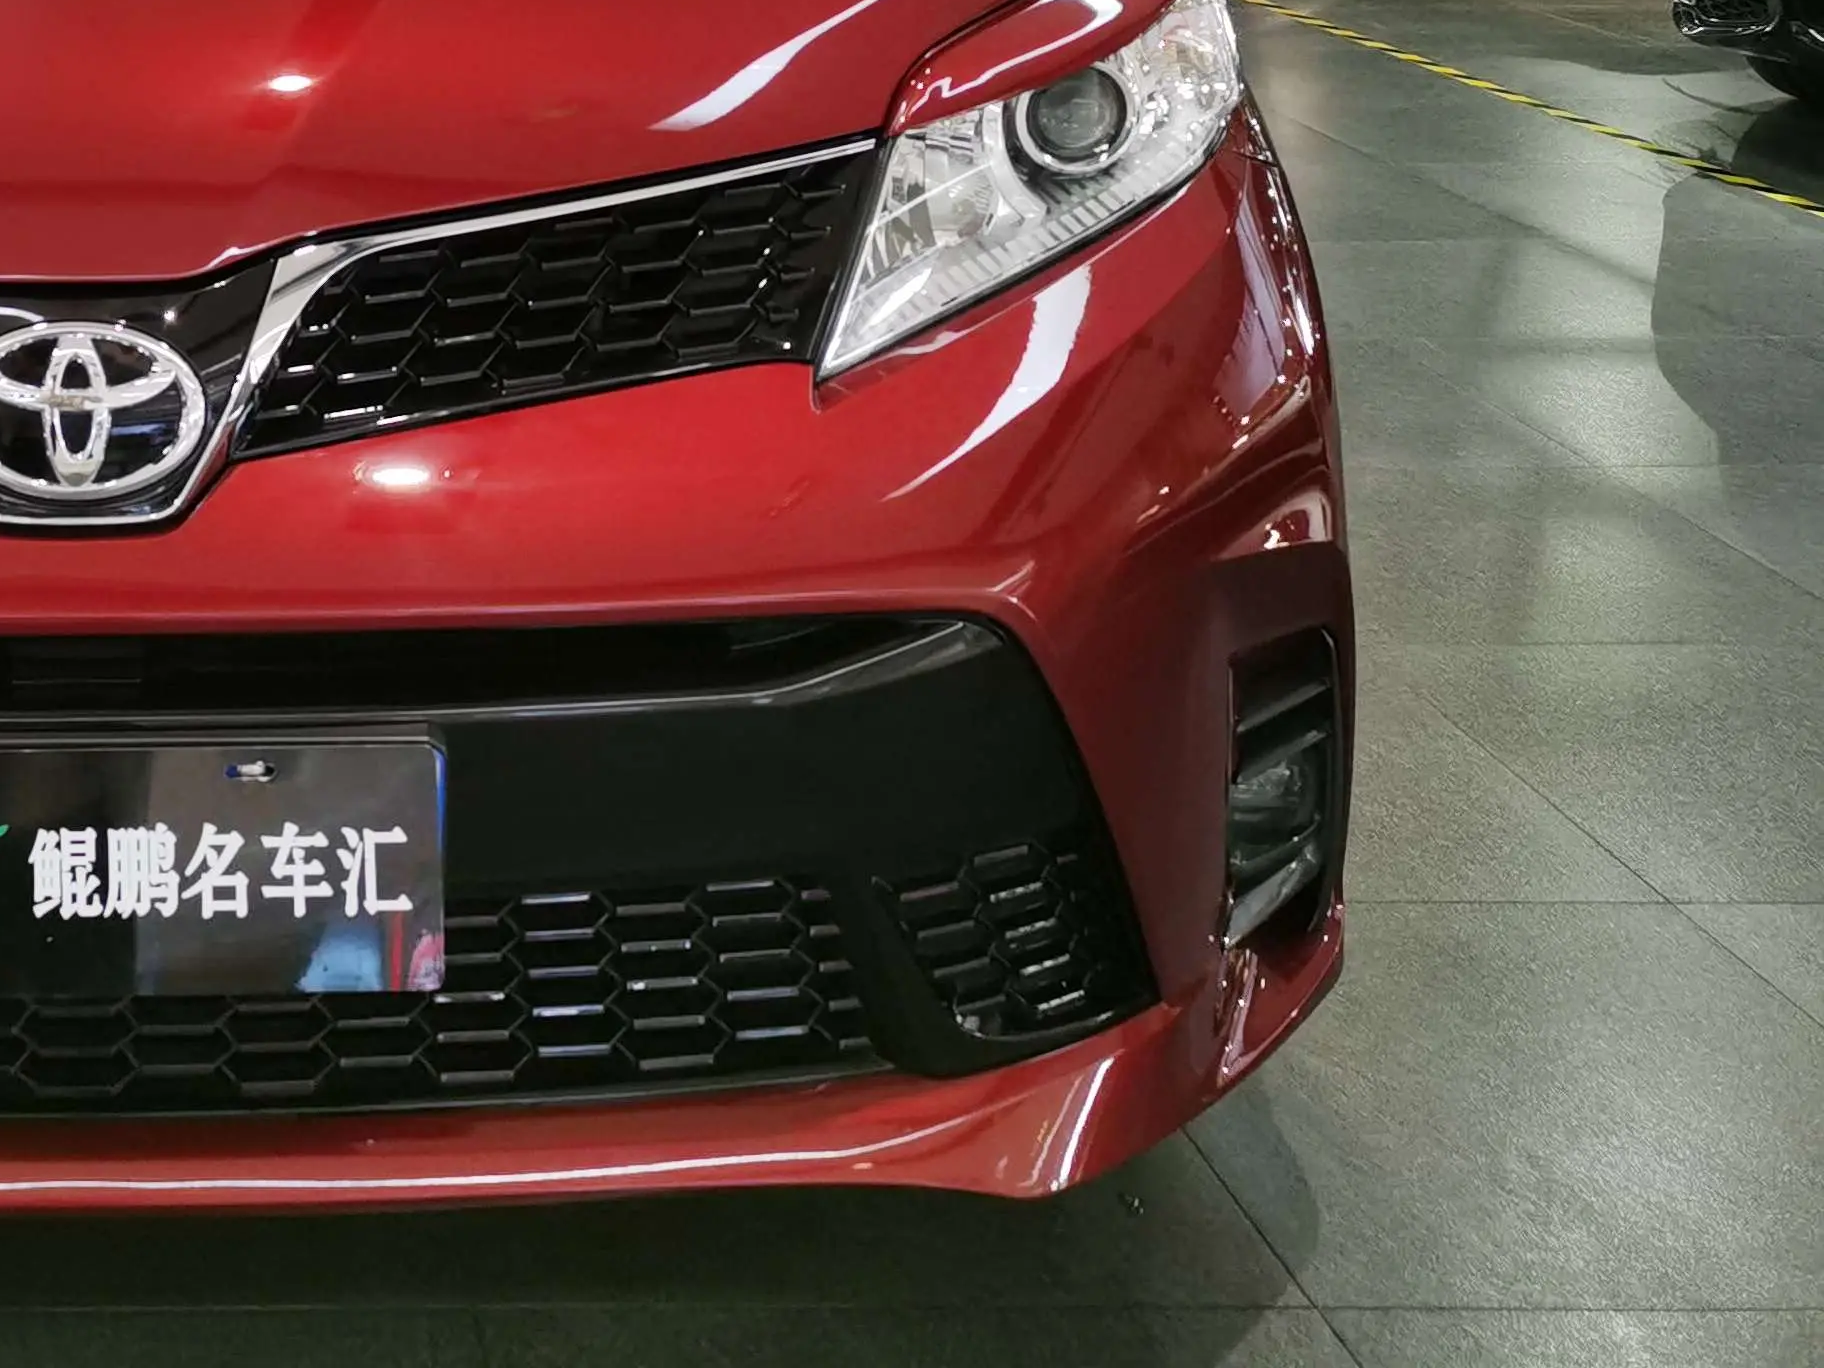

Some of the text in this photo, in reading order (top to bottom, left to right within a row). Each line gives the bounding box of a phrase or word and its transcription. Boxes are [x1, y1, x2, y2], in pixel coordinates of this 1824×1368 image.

[27, 822, 415, 921] 鲲鹏名车汇
